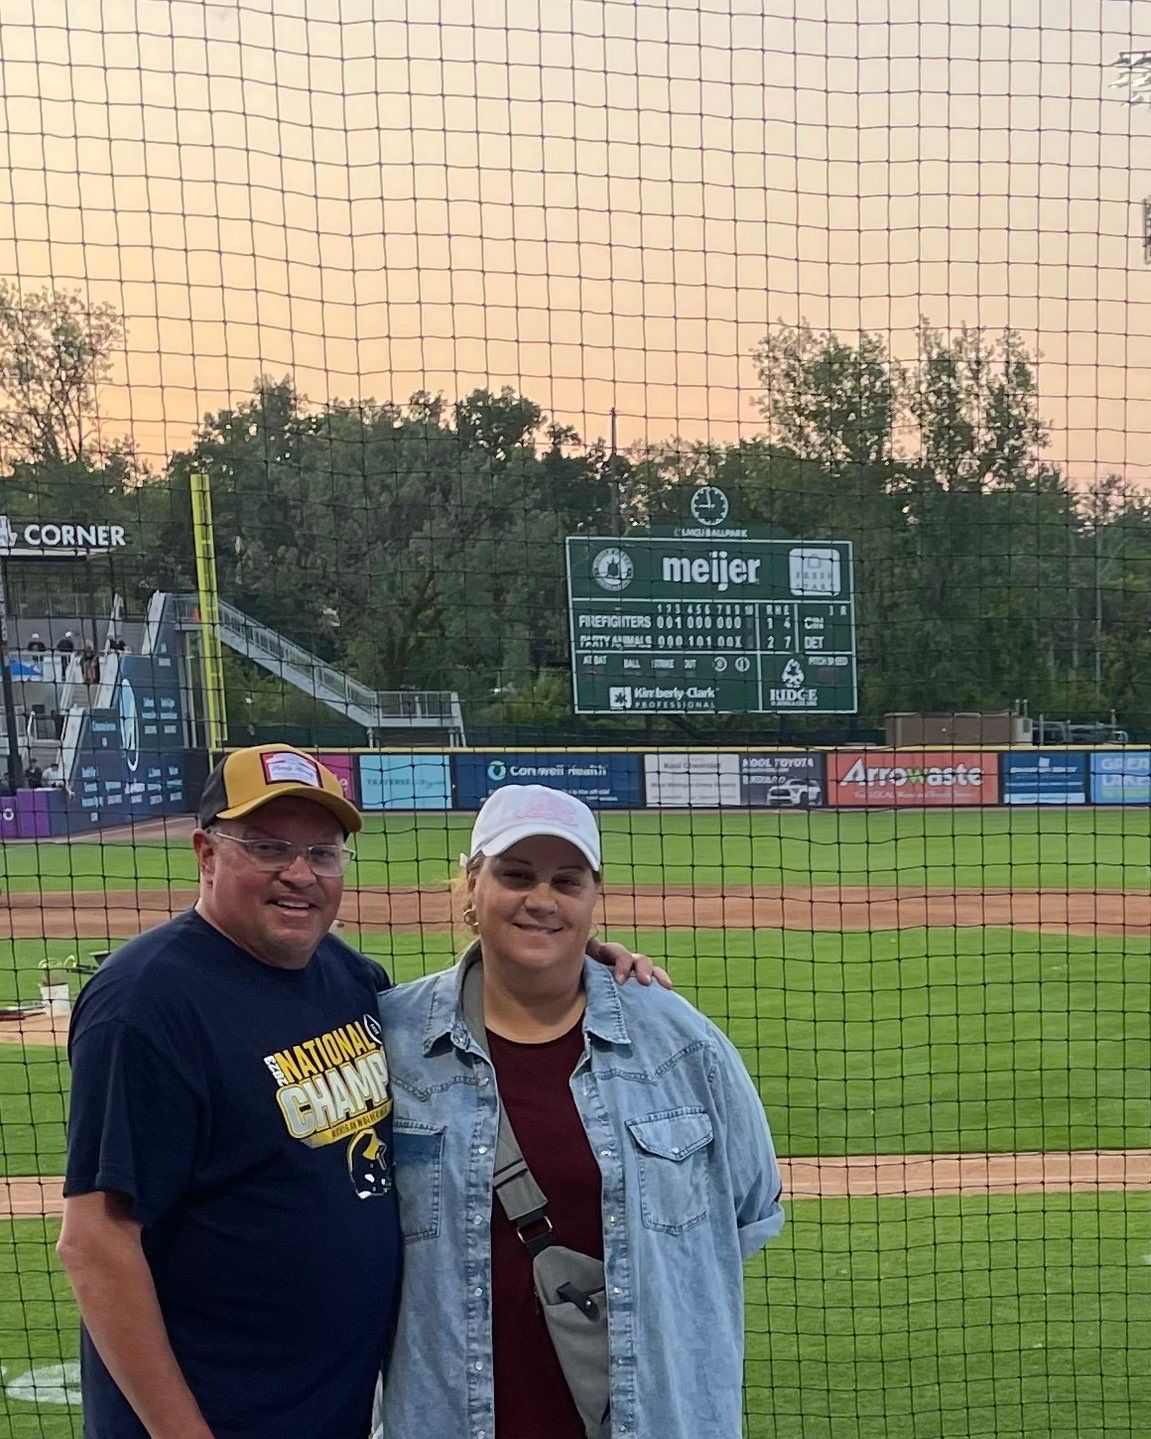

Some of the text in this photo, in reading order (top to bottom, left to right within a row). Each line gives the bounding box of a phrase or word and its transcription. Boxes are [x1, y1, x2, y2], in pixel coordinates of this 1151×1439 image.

[24, 524, 126, 546] CORNER
[662, 551, 761, 591] meijer
[578, 615, 652, 628] FIREFIGHTERS
[804, 636, 824, 649] DET
[634, 701, 716, 709] PROFESSIONAL
[774, 757, 815, 768] TOYOTA
[840, 758, 984, 787] Arrowaste
[273, 1020, 377, 1083] NATIONAL
